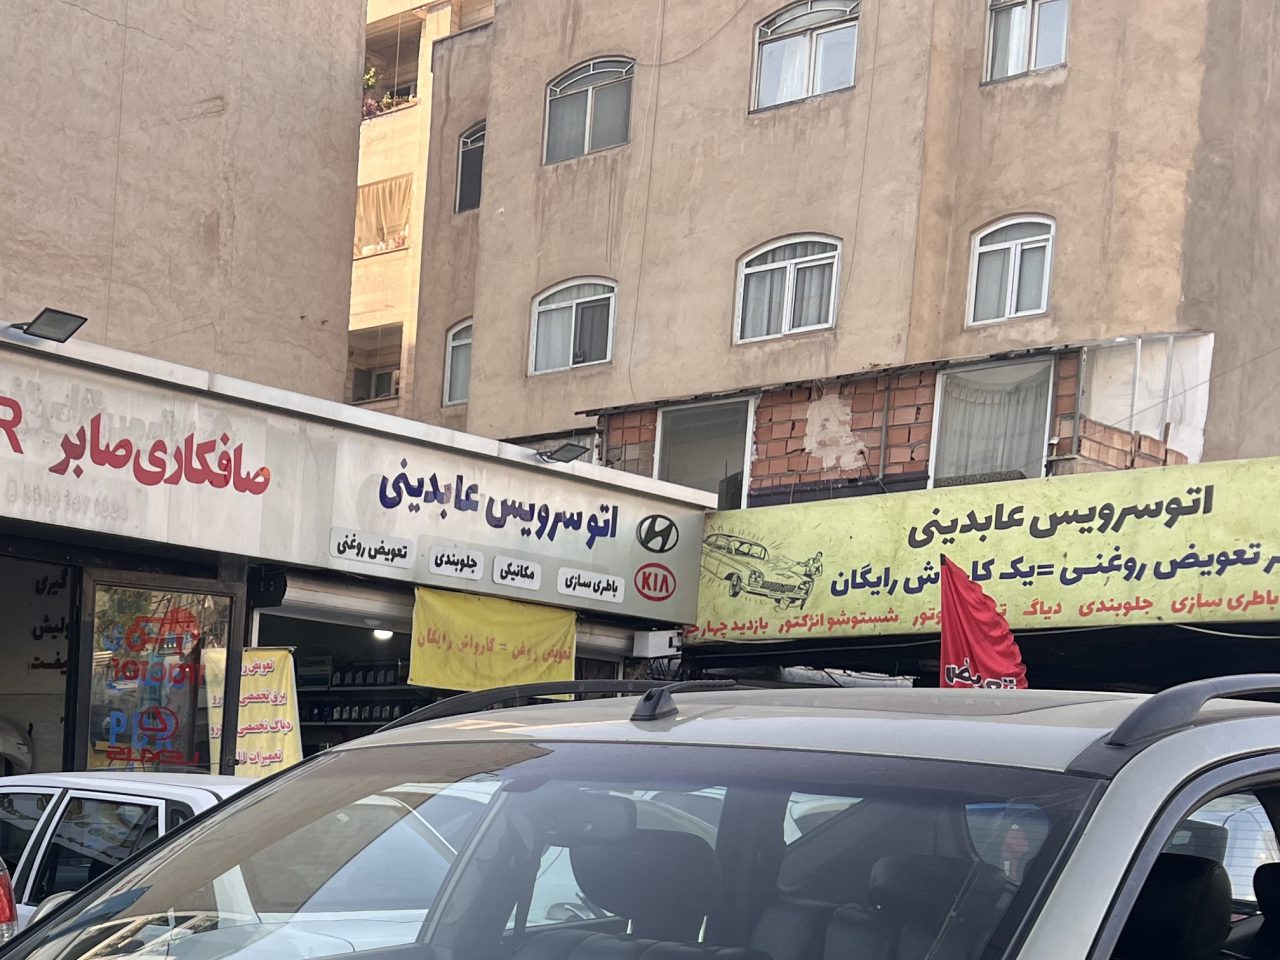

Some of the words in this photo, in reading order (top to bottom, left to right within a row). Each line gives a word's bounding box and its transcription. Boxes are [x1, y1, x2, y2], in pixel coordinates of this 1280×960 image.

[48, 412, 133, 480] صابر
[133, 432, 271, 496] صافکاری
[379, 457, 479, 520] عابدینی
[908, 503, 1024, 548] عابدینی
[337, 533, 365, 559] روغنی
[368, 539, 408, 560] تعویض
[435, 551, 478, 573] جلوبندی
[1060, 545, 1148, 586] روغنی
[1154, 543, 1261, 579] تعویض
[500, 563, 535, 582] مکانیکی
[565, 574, 591, 591] سازی
[642, 574, 669, 593] KIA
[830, 563, 899, 597] رایگان
[593, 578, 618, 595] باطری
[1023, 598, 1062, 619] دیاگ
[1079, 596, 1154, 618] جلوبندی
[1171, 593, 1223, 614] سازی
[1227, 590, 1279, 612] باطری
[32, 615, 70, 641] ولیش
[701, 620, 728, 638] چهار
[731, 617, 768, 635] بازدید
[778, 611, 824, 635] انژکتور
